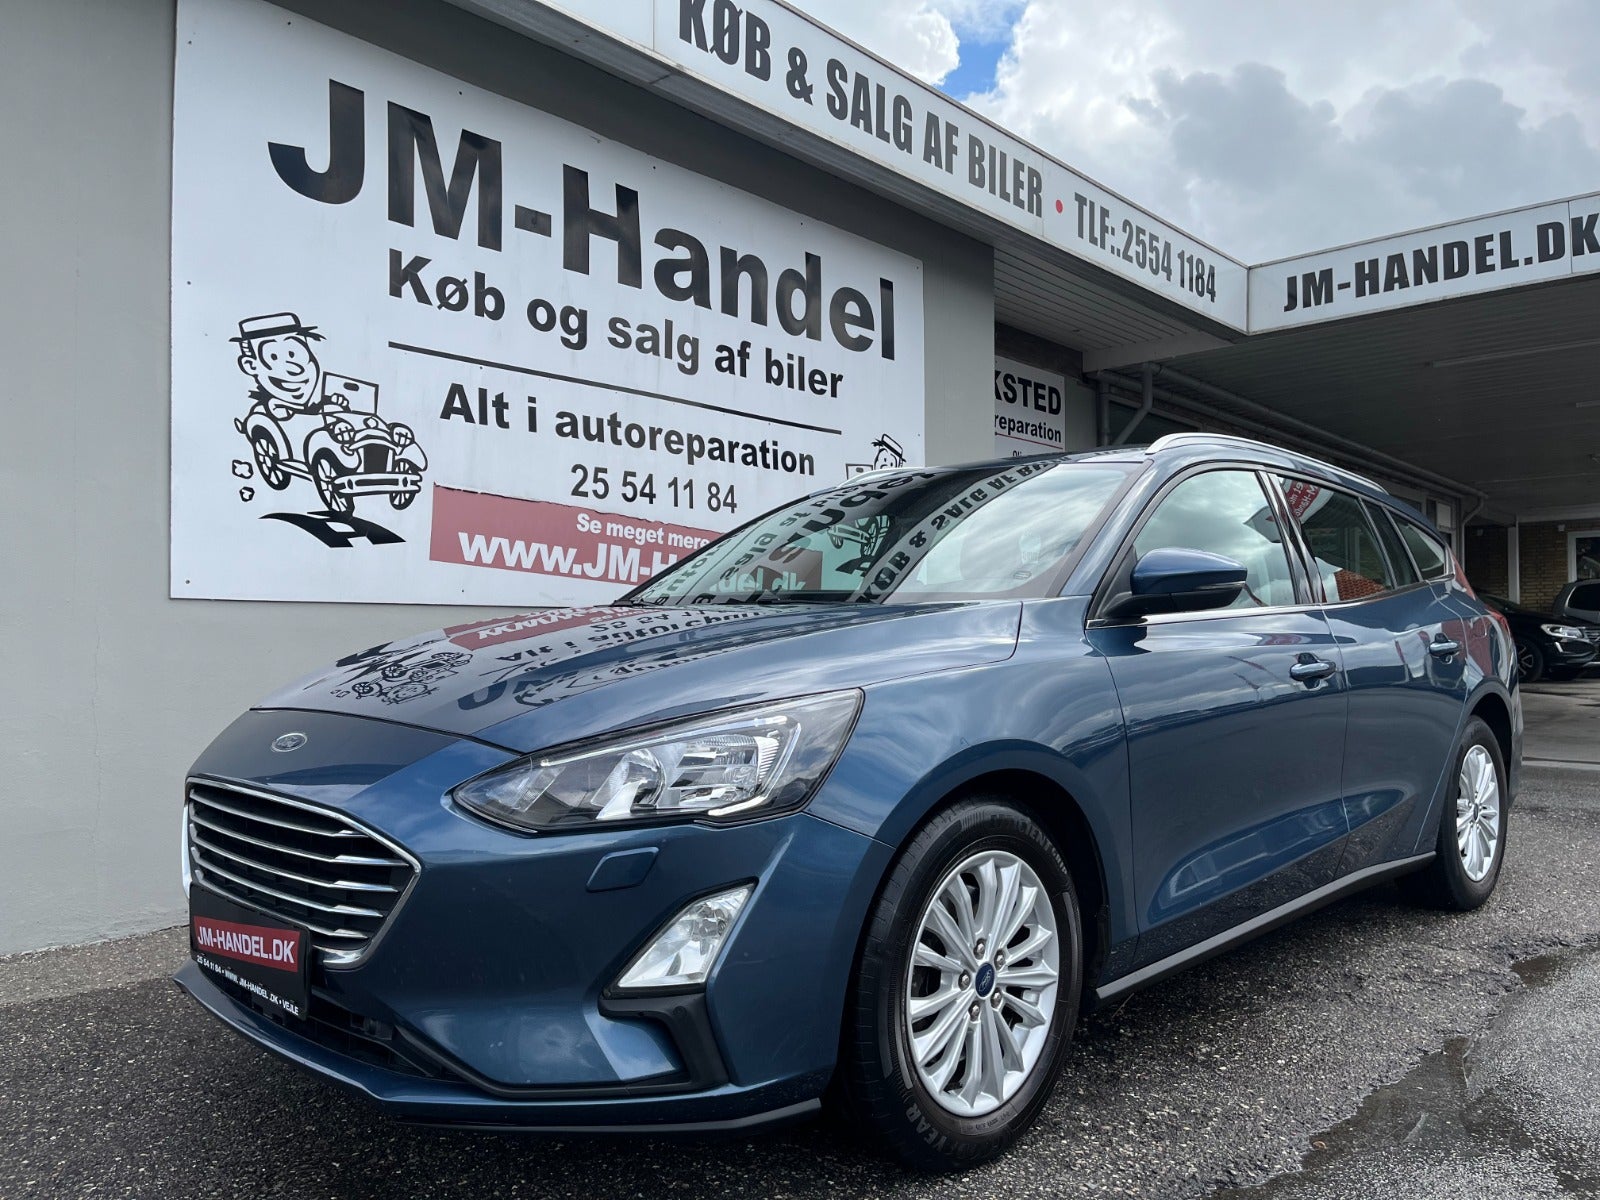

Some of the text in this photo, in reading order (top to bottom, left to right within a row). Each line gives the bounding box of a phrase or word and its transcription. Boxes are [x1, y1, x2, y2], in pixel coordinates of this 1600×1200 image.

[679, 0, 771, 82] KØB
[786, 47, 813, 106] &
[826, 58, 913, 155] SALG
[923, 111, 959, 175] AF
[968, 133, 1042, 218] BILER
[1177, 249, 1216, 303] 1184
[267, 79, 895, 361] JM-Handel
[1283, 212, 1600, 313] JM-HANDEL.DK
[389, 248, 844, 398] Køb og salg af biler
[440, 383, 815, 476] Alt i autoreparation
[571, 464, 737, 513] 25 54 11 84
[576, 513, 710, 550] Se meget mere
[197, 926, 295, 964] JM-HANDEL.DK
[282, 999, 299, 1017] VEJLE
